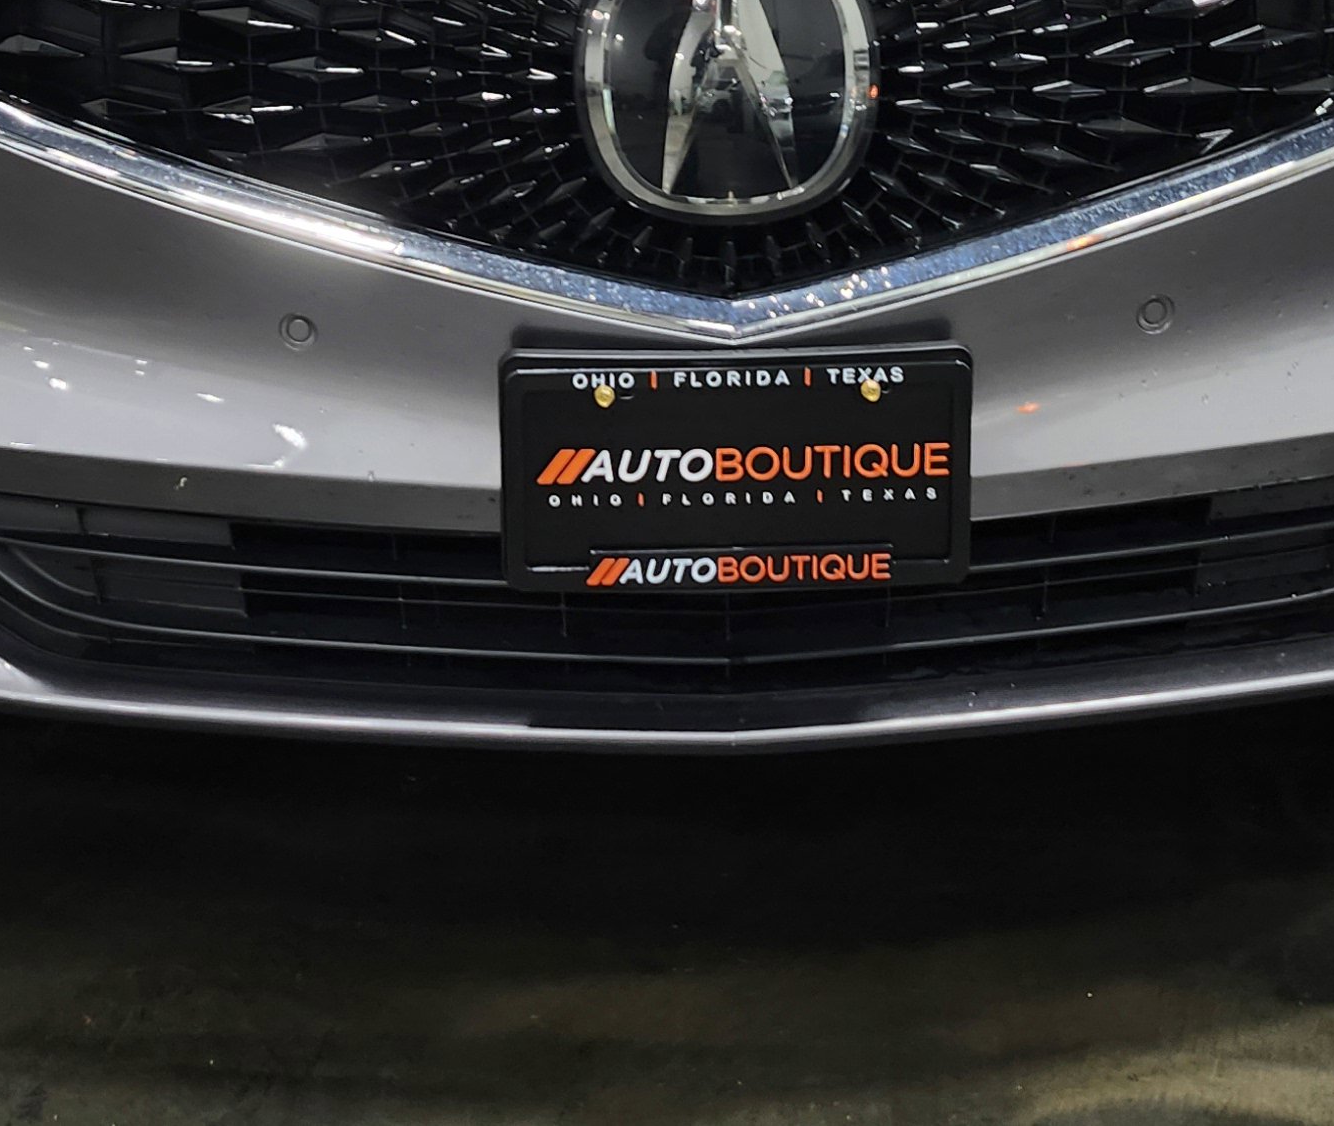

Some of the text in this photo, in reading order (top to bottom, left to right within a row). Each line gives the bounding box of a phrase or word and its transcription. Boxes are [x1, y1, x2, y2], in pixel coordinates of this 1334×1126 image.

[571, 366, 904, 391] OHIO FLORIDA TEXAS
[581, 442, 951, 483] AUTOBOUTIQUE
[548, 486, 938, 508] OHIO FLORIDA TEXAS
[618, 553, 892, 585] AUTOBOUTIQUE
